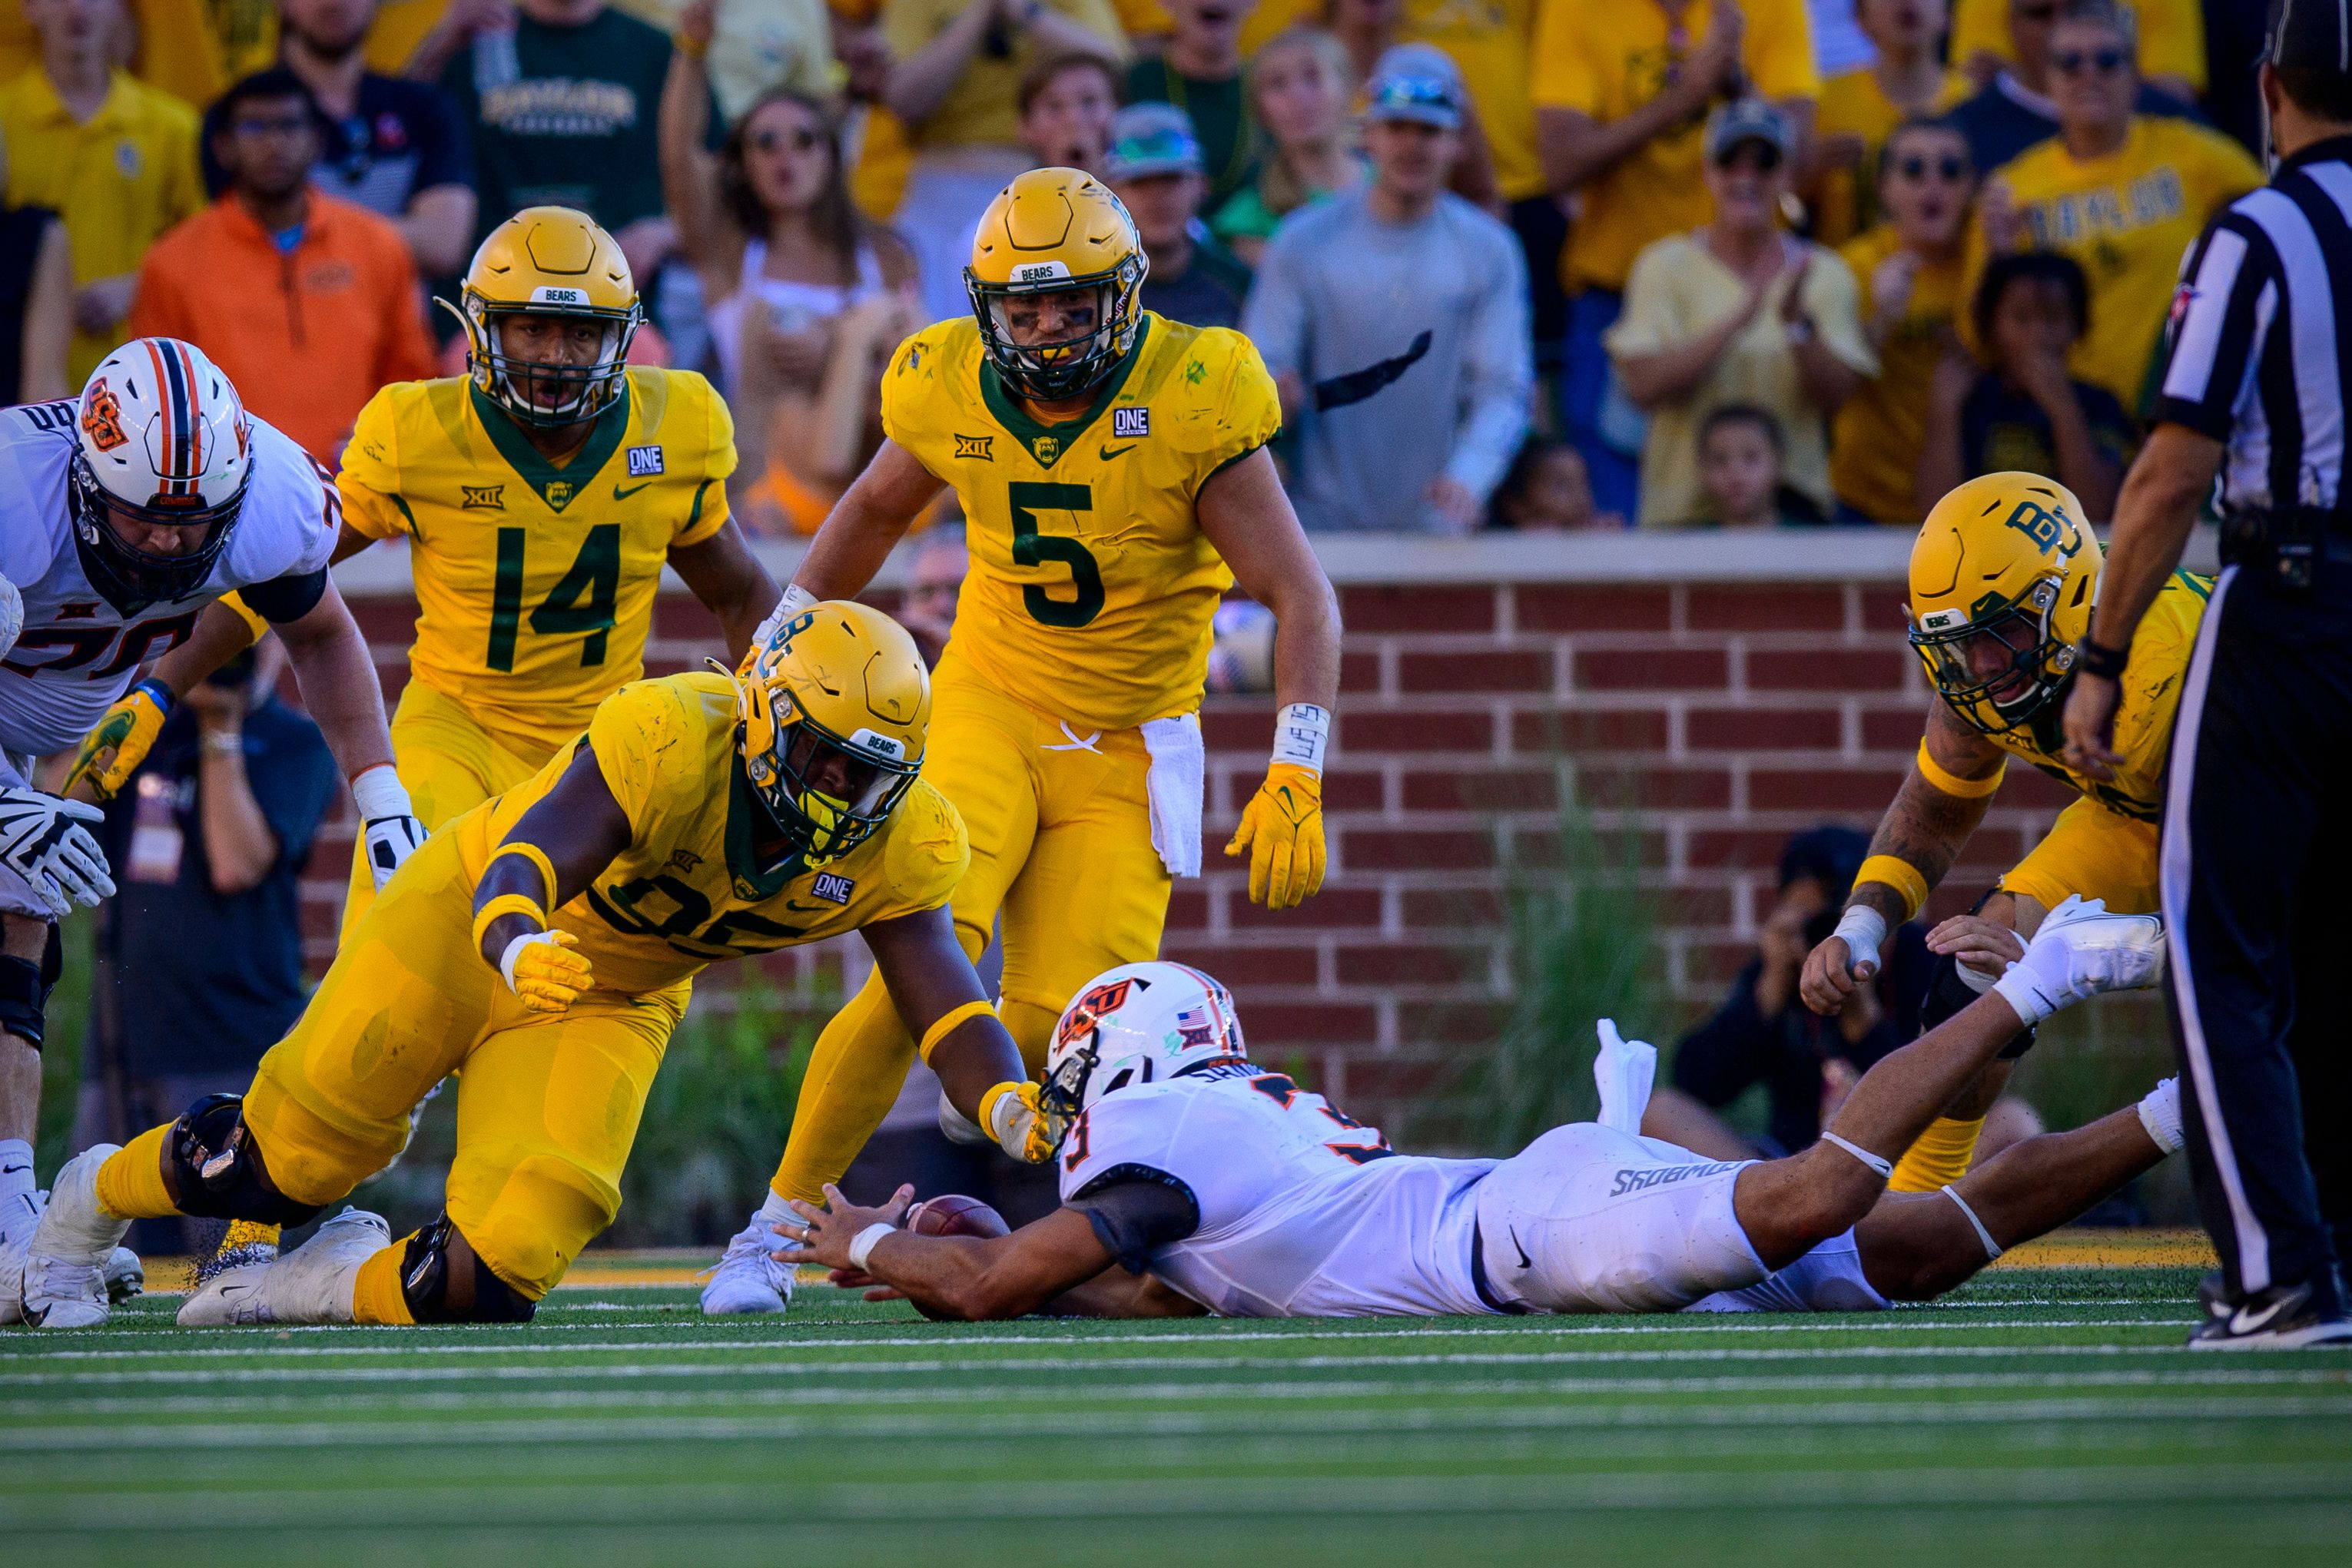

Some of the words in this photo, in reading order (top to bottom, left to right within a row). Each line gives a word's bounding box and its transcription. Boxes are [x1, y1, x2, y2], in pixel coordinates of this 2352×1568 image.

[1021, 267, 1053, 280] BEARS
[546, 290, 576, 302] BEARS
[81, 376, 130, 452] OSU
[1116, 409, 1147, 430] ONE
[629, 446, 662, 469] ONE
[2005, 501, 2082, 559] BU
[1009, 481, 1105, 628] 5
[486, 522, 621, 673] 14
[867, 735, 897, 754] BEARS
[814, 874, 853, 899] ONE
[1057, 976, 1135, 1057] OSU
